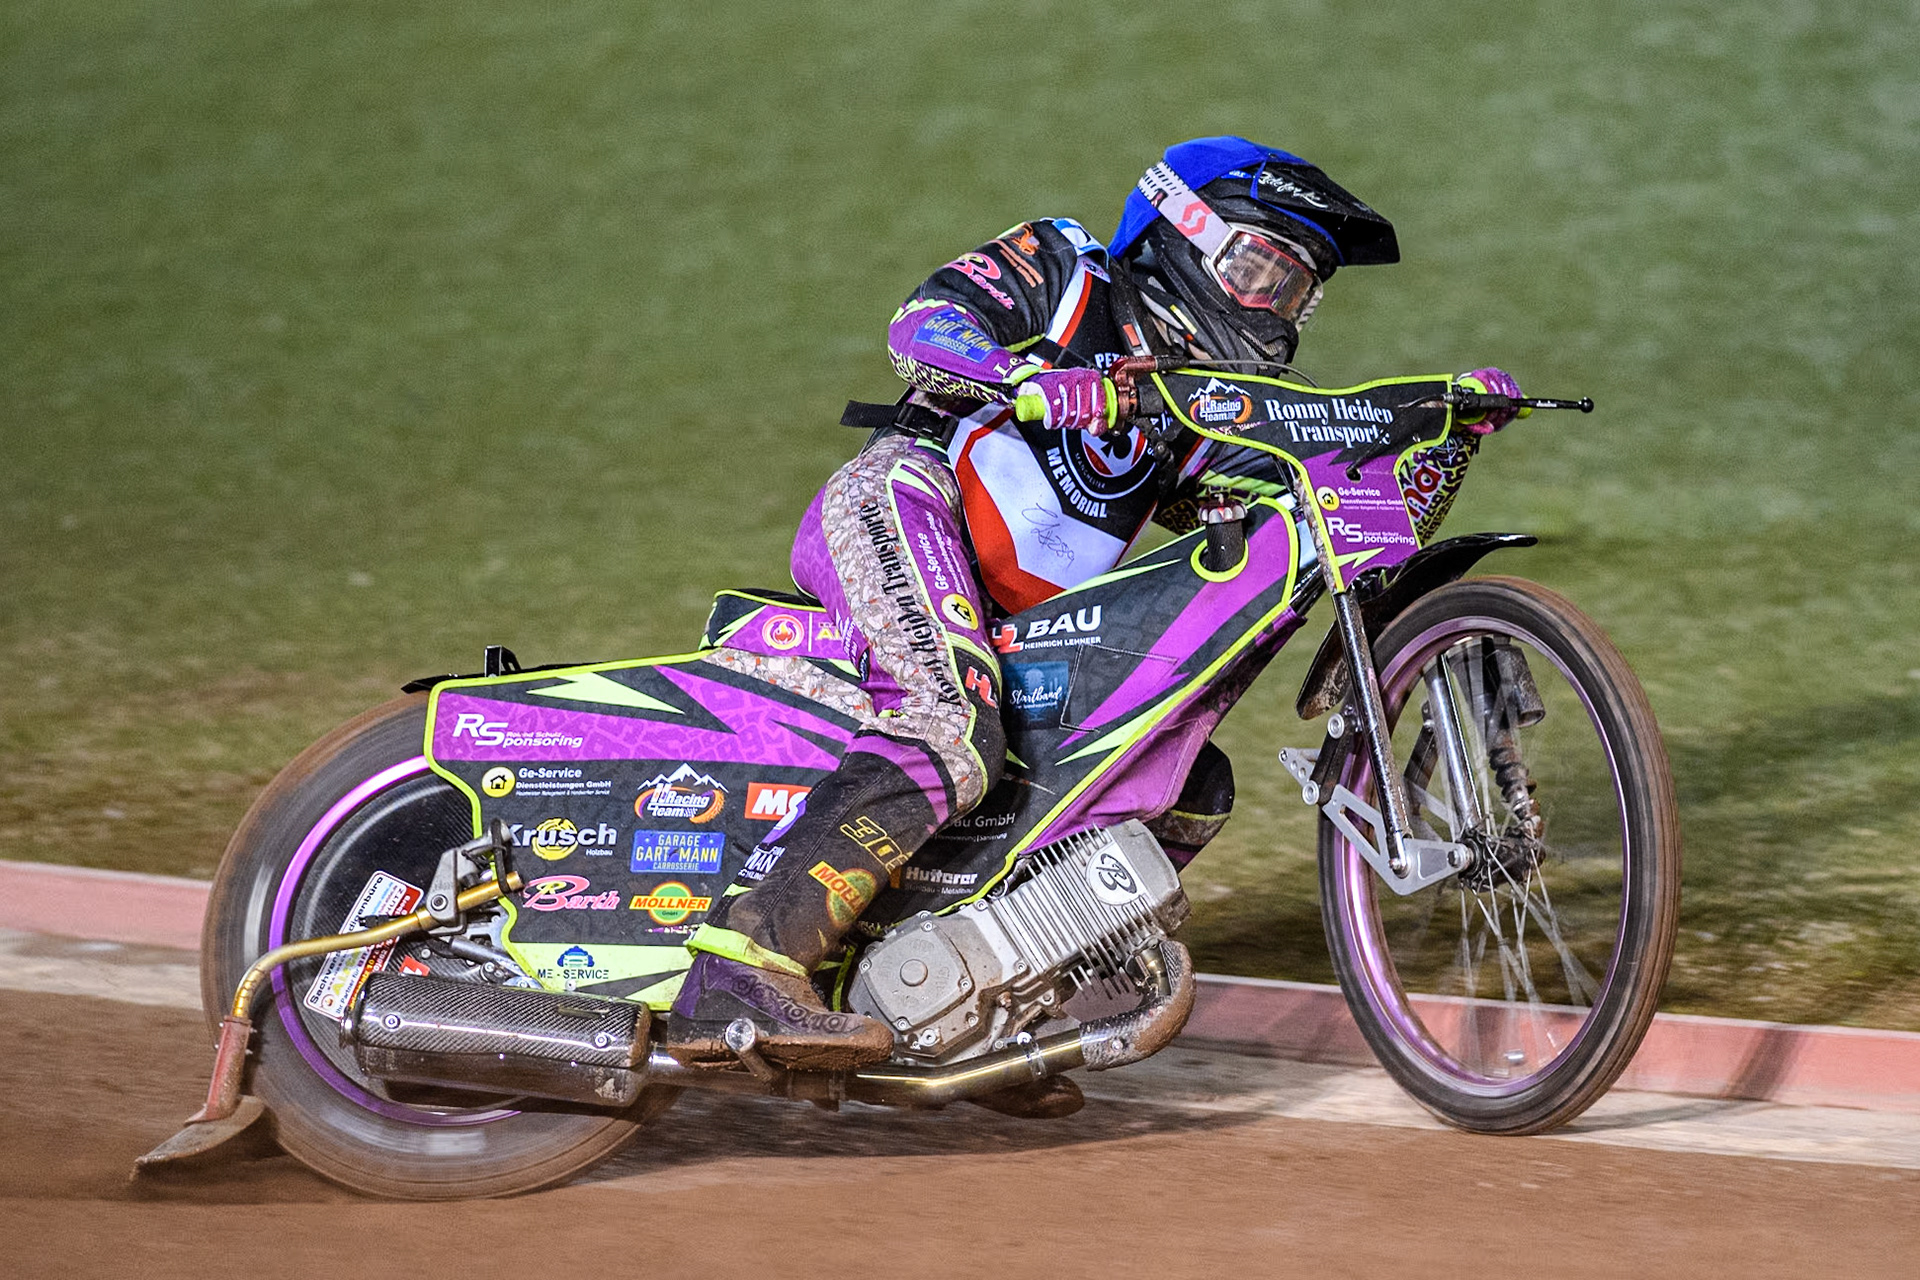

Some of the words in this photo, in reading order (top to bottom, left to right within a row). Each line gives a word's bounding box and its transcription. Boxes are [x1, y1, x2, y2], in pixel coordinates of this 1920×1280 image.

[1264, 399, 1329, 425] Ronny
[1331, 398, 1393, 425] Heiden
[1046, 446, 1108, 519] MEMORIAL
[858, 502, 911, 595] Transporte
[917, 532, 949, 590] Ge-Service
[1025, 605, 1102, 639] BAU
[1024, 639, 1063, 650] HEINRICH
[518, 767, 582, 778] Ge-Service
[516, 781, 585, 790] Dienstleistungen
[586, 780, 612, 788] GmbH
[975, 812, 1016, 828] GmbH
[658, 834, 701, 847] GARAGE
[635, 846, 671, 862] GART
[678, 847, 719, 863] MANN
[652, 862, 700, 871] CARROSSERIE
[634, 897, 709, 909] MOLLNER
[563, 968, 610, 980] SERVICE
[340, 980, 355, 1004] Partner
